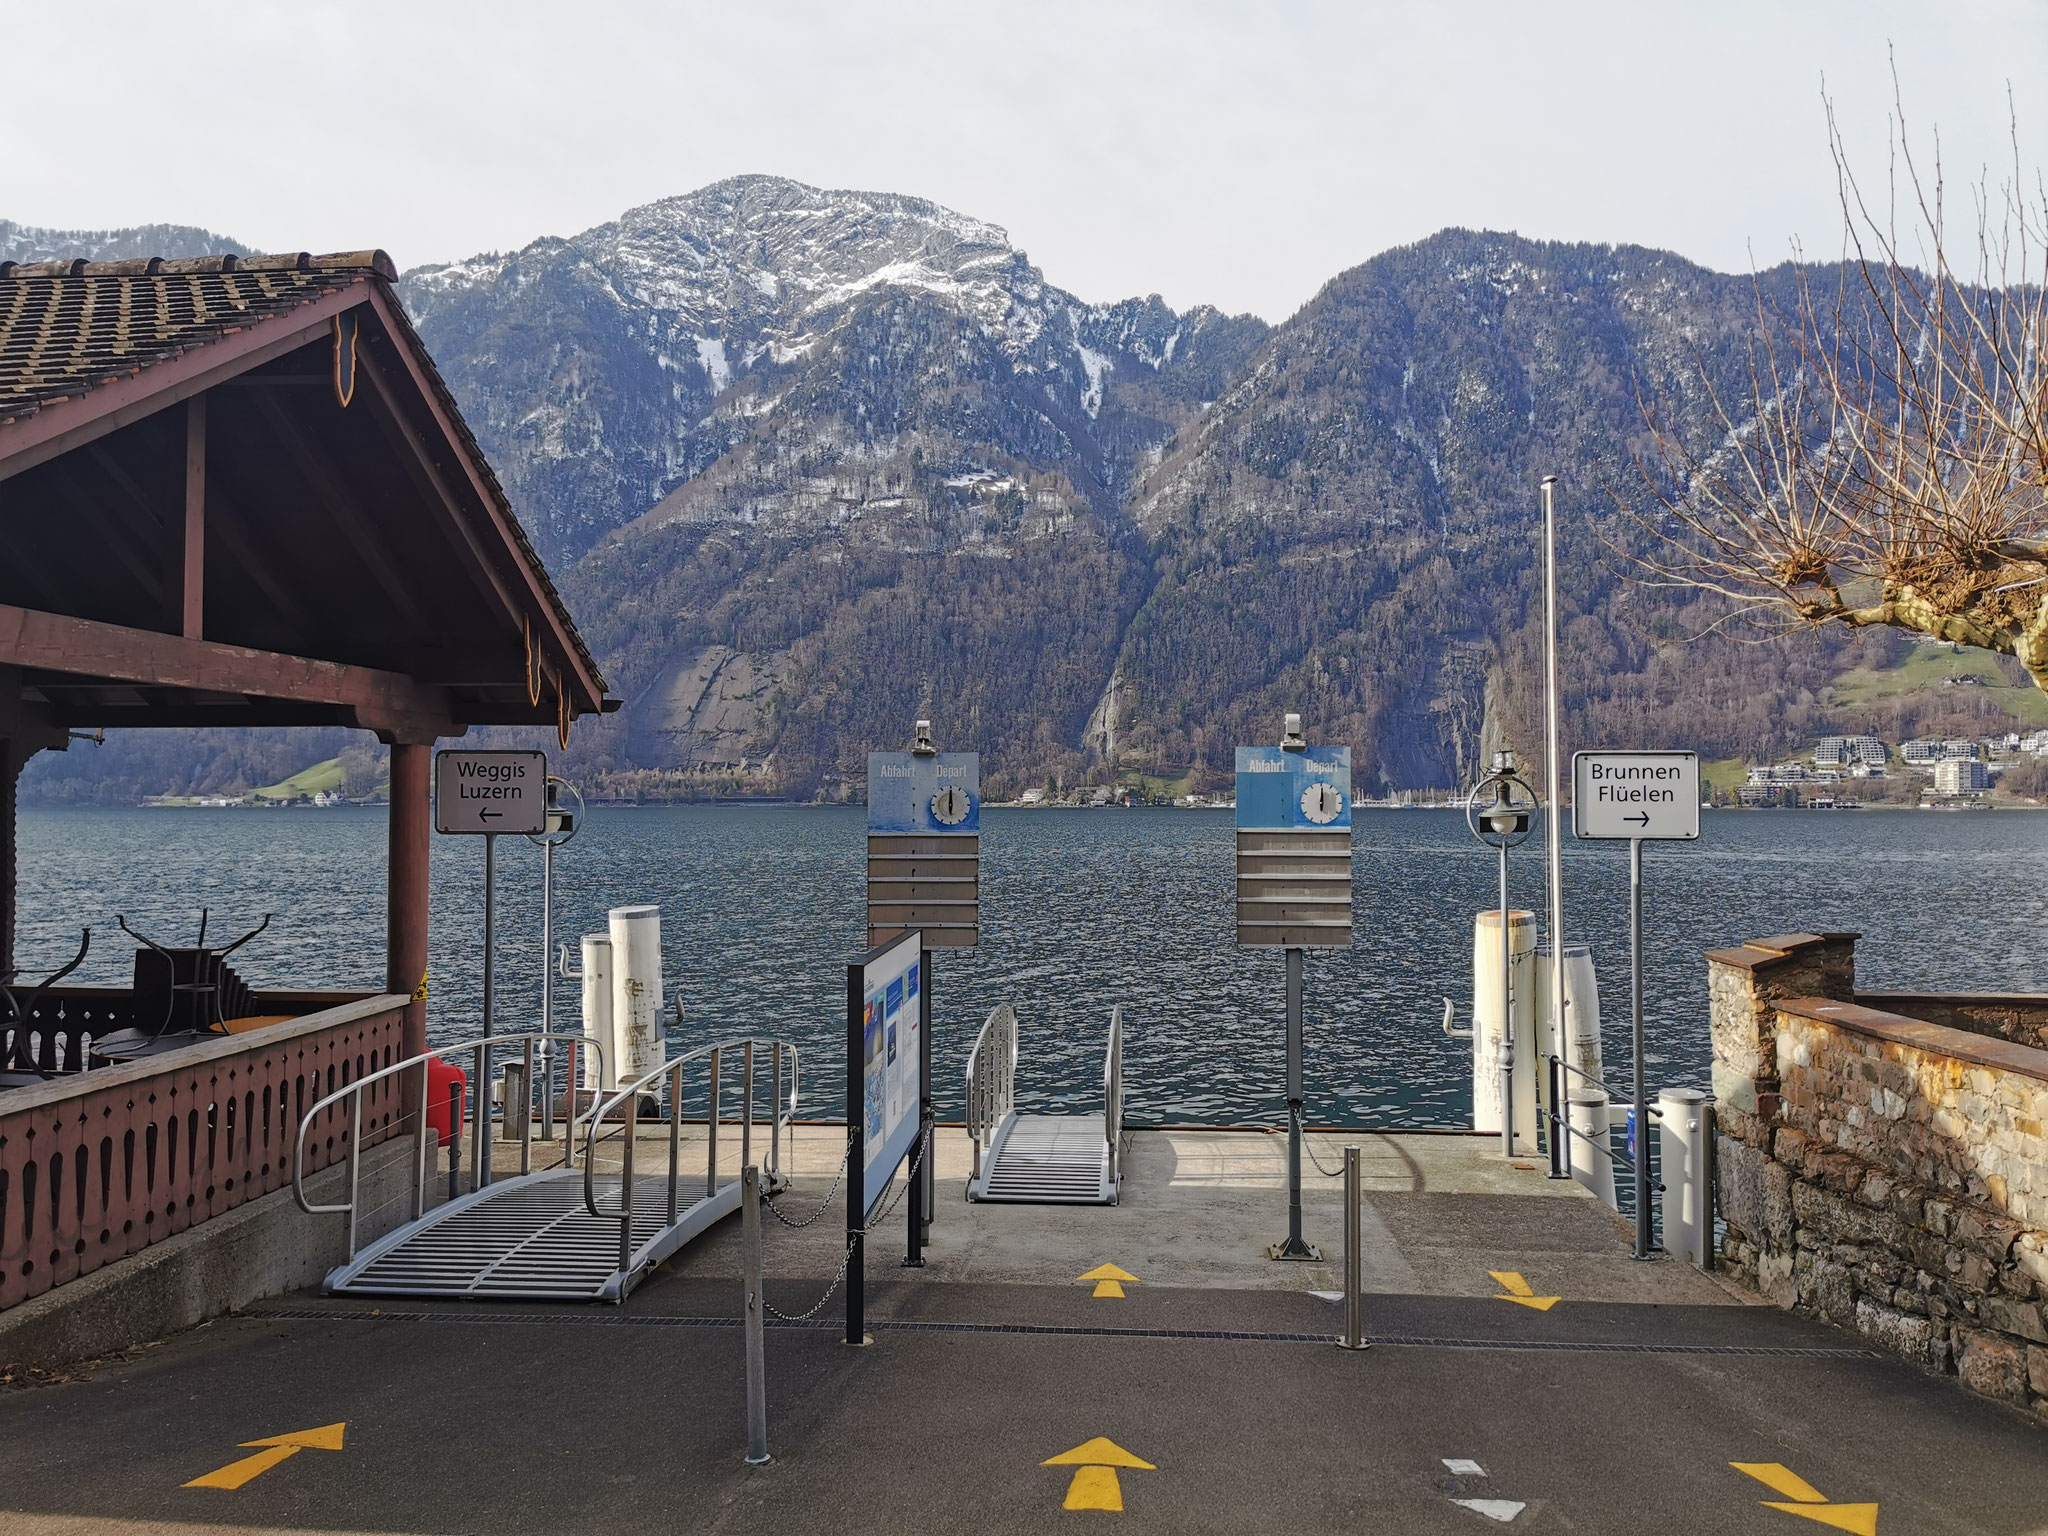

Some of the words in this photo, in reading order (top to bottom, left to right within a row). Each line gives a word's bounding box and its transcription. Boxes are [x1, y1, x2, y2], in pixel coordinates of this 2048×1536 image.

[457, 761, 525, 781] Weggis
[880, 764, 916, 778] Abfahrt
[1249, 759, 1285, 773] Abfahrt
[1592, 763, 1680, 779] Brunnen
[460, 785, 522, 799] Luzern
[1599, 785, 1674, 802] Flüelen
